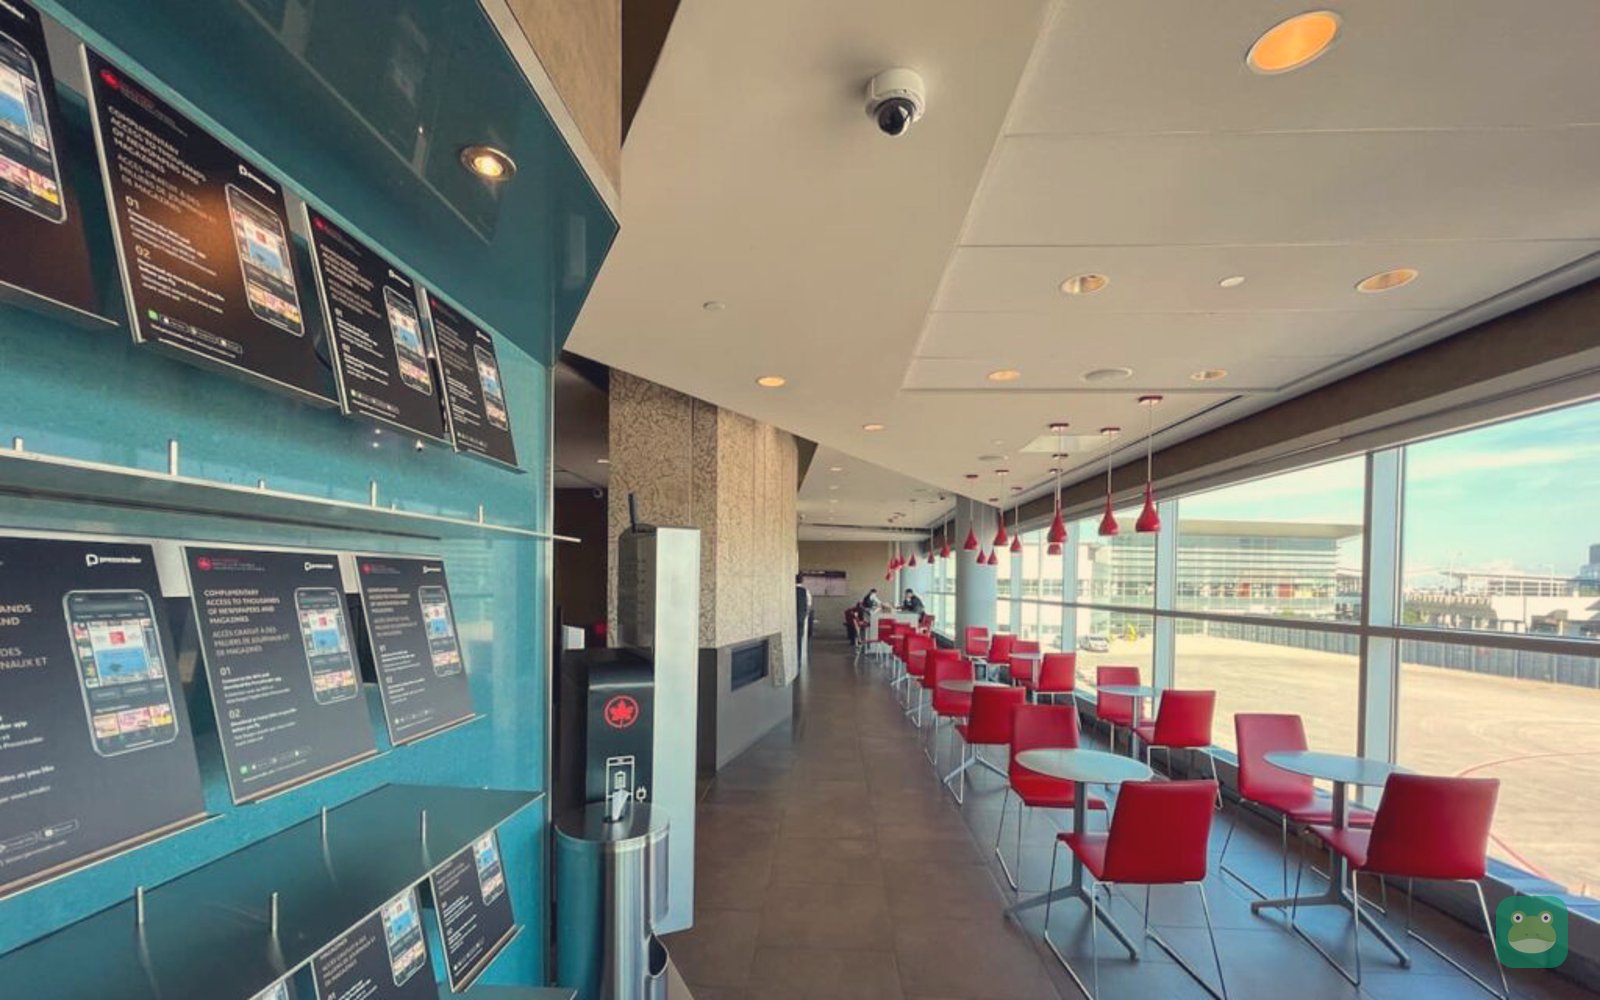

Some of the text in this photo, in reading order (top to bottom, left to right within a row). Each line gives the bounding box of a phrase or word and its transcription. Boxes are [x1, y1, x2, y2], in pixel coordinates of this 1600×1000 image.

[126, 195, 139, 211] 01
[135, 244, 151, 260] 02
[219, 665, 231, 677] 01
[228, 708, 241, 719] 02
